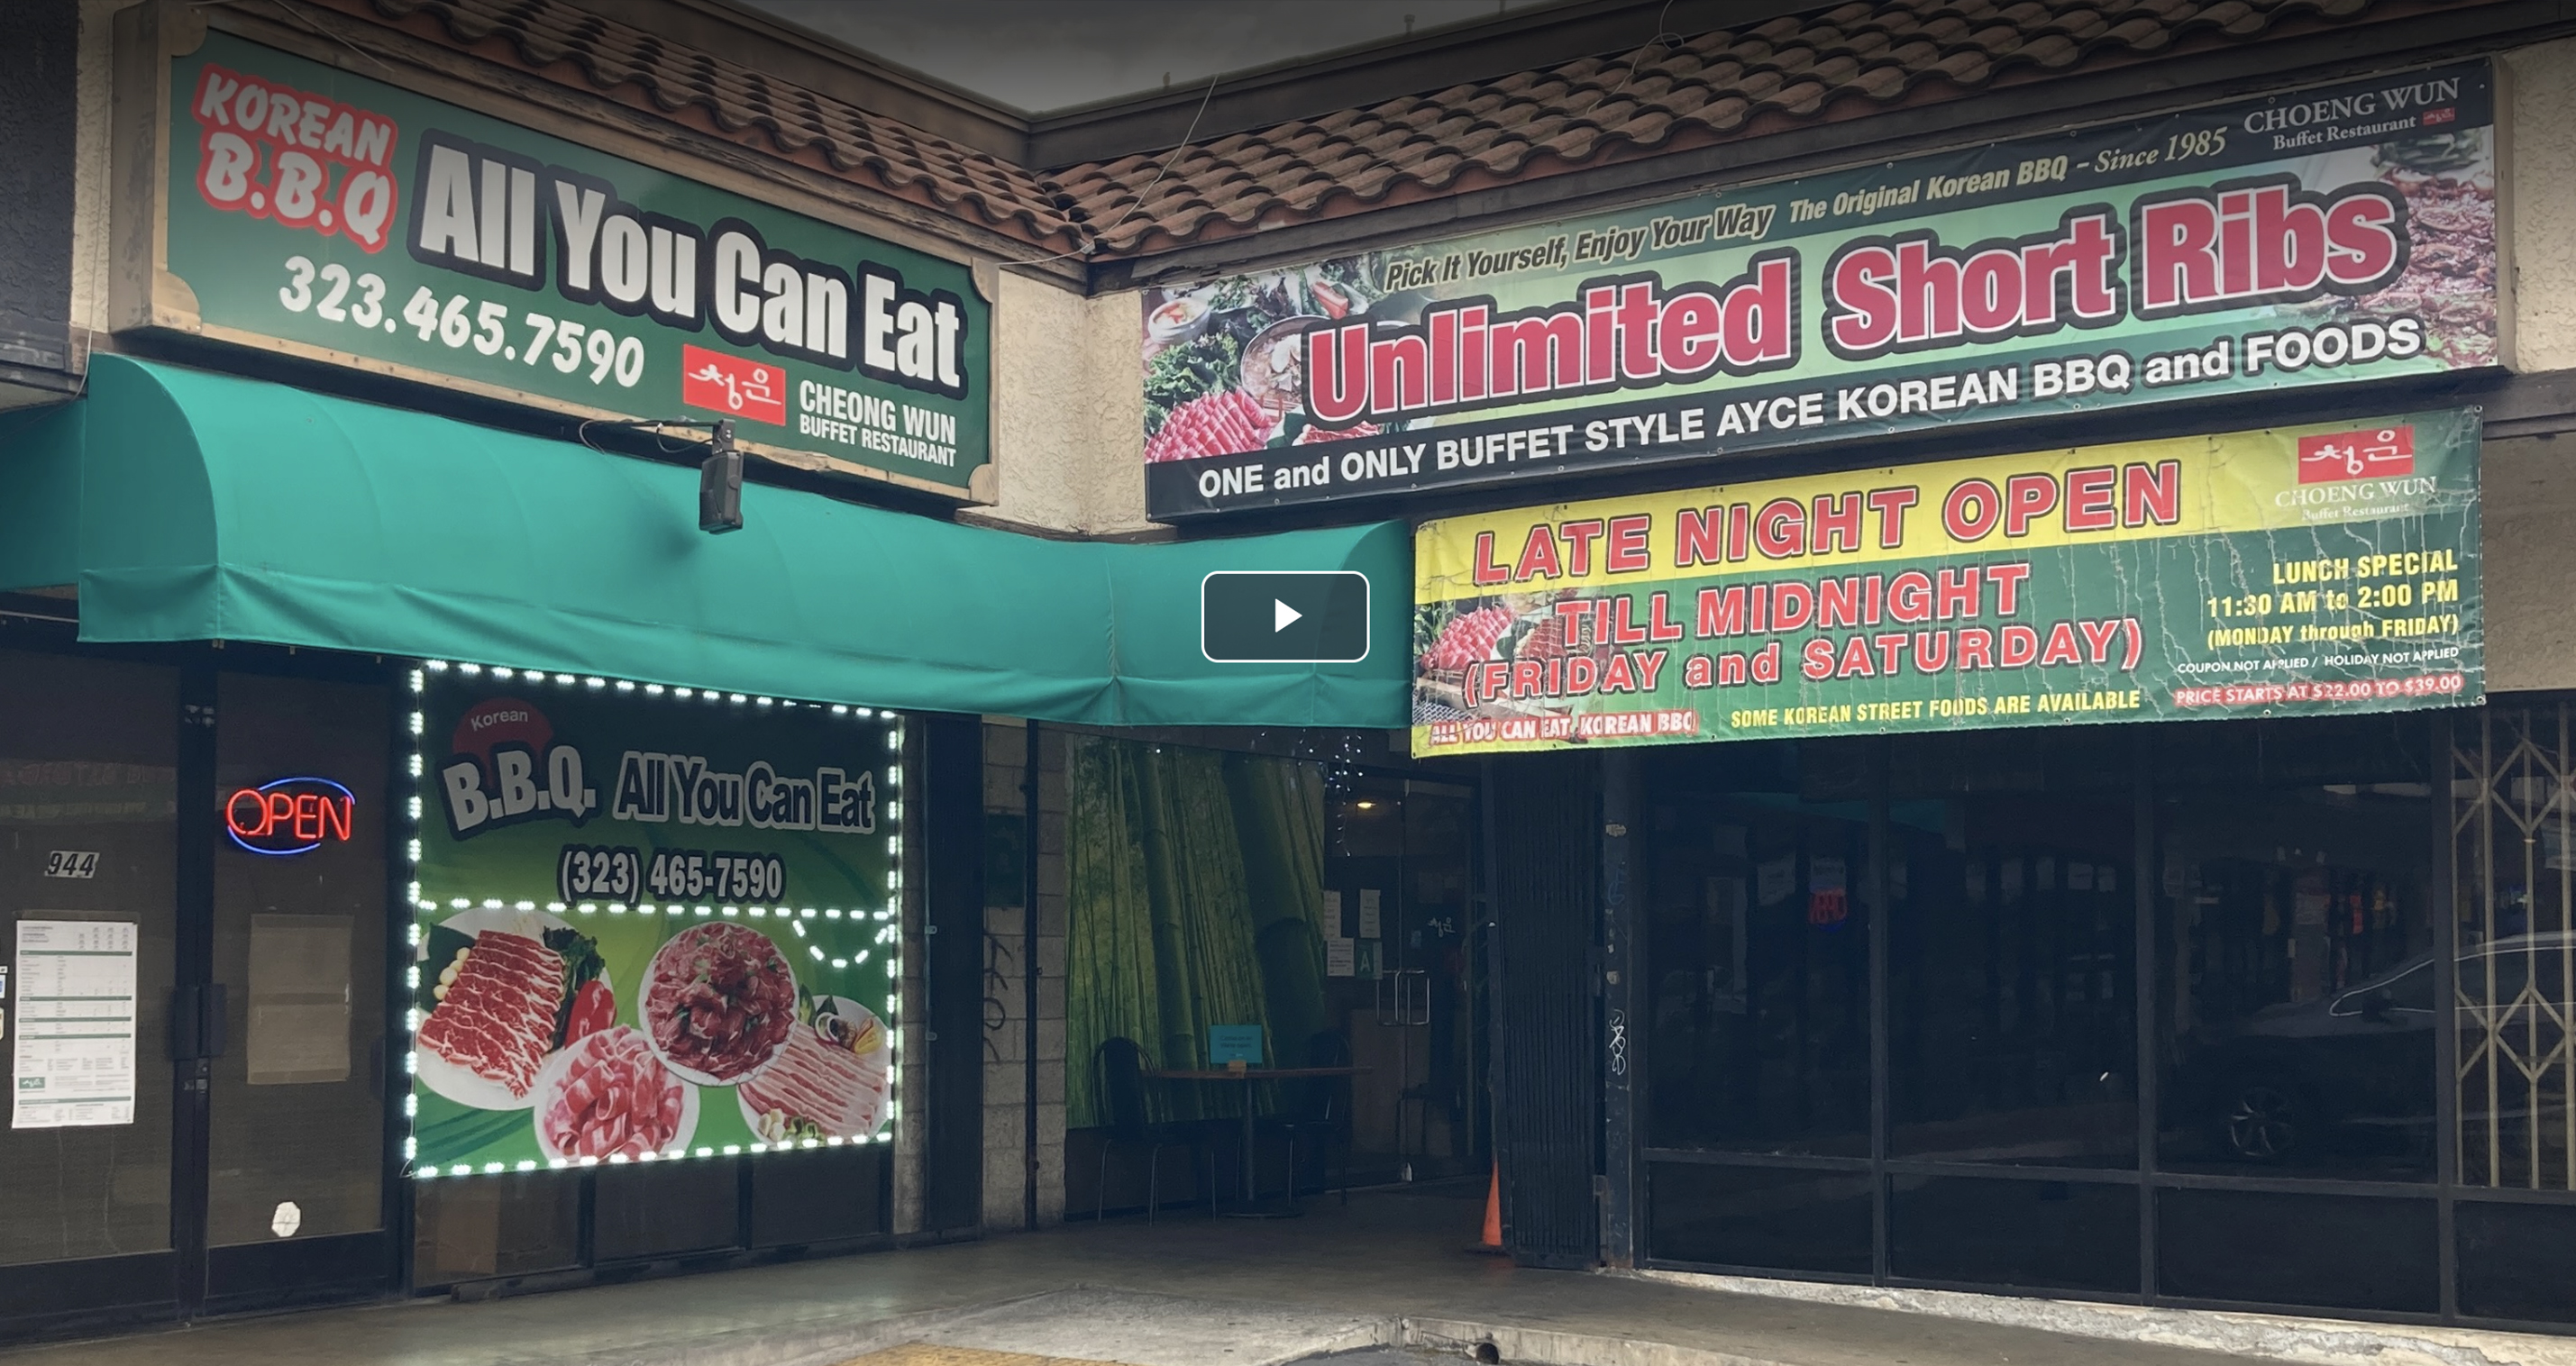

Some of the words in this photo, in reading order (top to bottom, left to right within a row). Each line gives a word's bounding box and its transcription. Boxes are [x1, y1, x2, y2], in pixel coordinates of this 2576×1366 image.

[198, 72, 391, 166] KOREAN
[2244, 93, 2375, 133] CHOENG
[2380, 77, 2460, 111] WUN
[2273, 130, 2323, 150] Buffet
[2327, 116, 2416, 142] Restaurant
[205, 132, 391, 246] B.B.Q
[1790, 199, 1826, 223] The
[1833, 180, 1918, 216] Original
[1926, 166, 2008, 201] Korean
[2016, 155, 2069, 186] BBQ
[2095, 149, 2159, 173] Since
[2164, 127, 2228, 162] 1985
[420, 144, 534, 276] All
[555, 180, 696, 318] You
[715, 232, 846, 359] Can
[865, 274, 960, 387] Eat
[1384, 260, 1435, 290] Pick
[1442, 256, 1460, 281] It
[1467, 239, 1567, 278] Yourself,
[1576, 227, 1645, 261] Enjoy
[1652, 217, 1711, 247] Your
[1716, 206, 1773, 237] Way
[279, 255, 645, 388] 323.465.7590
[1309, 258, 1791, 422] Unlimited
[1832, 214, 2115, 350] Short
[2142, 184, 2397, 309] Ribs
[689, 363, 781, 410] 청은
[1199, 465, 1263, 497] ONE
[1274, 457, 1329, 489] and
[1341, 444, 1426, 480] ONLY
[1437, 426, 1574, 470] BUFFET
[1585, 408, 1704, 451] STYLE
[1717, 394, 1823, 436] AYCE
[1838, 368, 2017, 421] KOREAN
[2034, 355, 2130, 396] BBQ
[2146, 342, 2229, 383] and
[2248, 320, 2420, 371] FOODS
[799, 380, 896, 433] CHEONG
[902, 399, 956, 446] WUN
[799, 414, 857, 446] BUFFET
[862, 430, 956, 468] RESTAURANT
[2301, 430, 2413, 475] 청은
[2275, 483, 2375, 507] CHOENG
[2380, 477, 2436, 496] WUN
[2302, 508, 2339, 521] Buffet
[2343, 503, 2409, 517] Restaurant
[1475, 515, 1649, 585] LATE
[1676, 487, 1917, 568] NIGHT
[1942, 462, 2179, 540] OPEN
[2273, 558, 2349, 585] LUNCH
[2358, 549, 2458, 578] SPECIAL
[1556, 594, 1683, 646] TILL
[1697, 562, 2030, 636] MIDNIGHT
[2207, 595, 2272, 617] 11:30
[2280, 590, 2316, 614] AM
[2326, 590, 2348, 609] to
[2358, 584, 2411, 608] 2:00
[2422, 579, 2458, 605] PM
[2207, 625, 2293, 651] (MONDAY
[2300, 621, 2374, 642] through
[2382, 615, 2459, 637] FRIDAY)
[1464, 651, 1667, 707] (FRIDAY
[1685, 642, 1780, 688] and
[1804, 617, 2142, 679] SATURDAY)
[2178, 662, 2231, 673] COUPON
[2234, 660, 2260, 670] NOT
[2325, 654, 2380, 666] HOLIDAY
[2383, 652, 2410, 663] NOT
[2413, 647, 2459, 661] APPLIED
[1731, 710, 1777, 728] SOME
[1784, 706, 1851, 724] KOREAN
[1857, 701, 1923, 721] STREET
[1929, 697, 1987, 716] FOODS
[1994, 695, 2031, 714] ARE
[2037, 690, 2141, 712] AVAILABLE
[2177, 689, 2221, 703] PRICE
[2226, 688, 2282, 701] STARTS
[2288, 686, 2307, 698] AT
[2314, 683, 2370, 697] $22.00
[2376, 682, 2399, 695] TO
[2405, 677, 2461, 692] $39.00
[470, 708, 528, 732] Korean
[1430, 724, 1457, 744] ALL
[1463, 722, 1495, 742] YOU
[1502, 721, 1536, 739] CAN
[1541, 716, 1570, 738] EAT
[1581, 714, 1652, 735] KOREAN
[225, 789, 352, 841] OPEN
[443, 745, 596, 831] B.B.Q.
[613, 751, 669, 822] All
[670, 754, 743, 825] You
[745, 760, 815, 830] Can
[817, 767, 875, 834] Eat
[48, 852, 96, 876] 944
[562, 850, 639, 903] (323)
[651, 854, 782, 898] 465-7590
[1360, 952, 1371, 971] A
